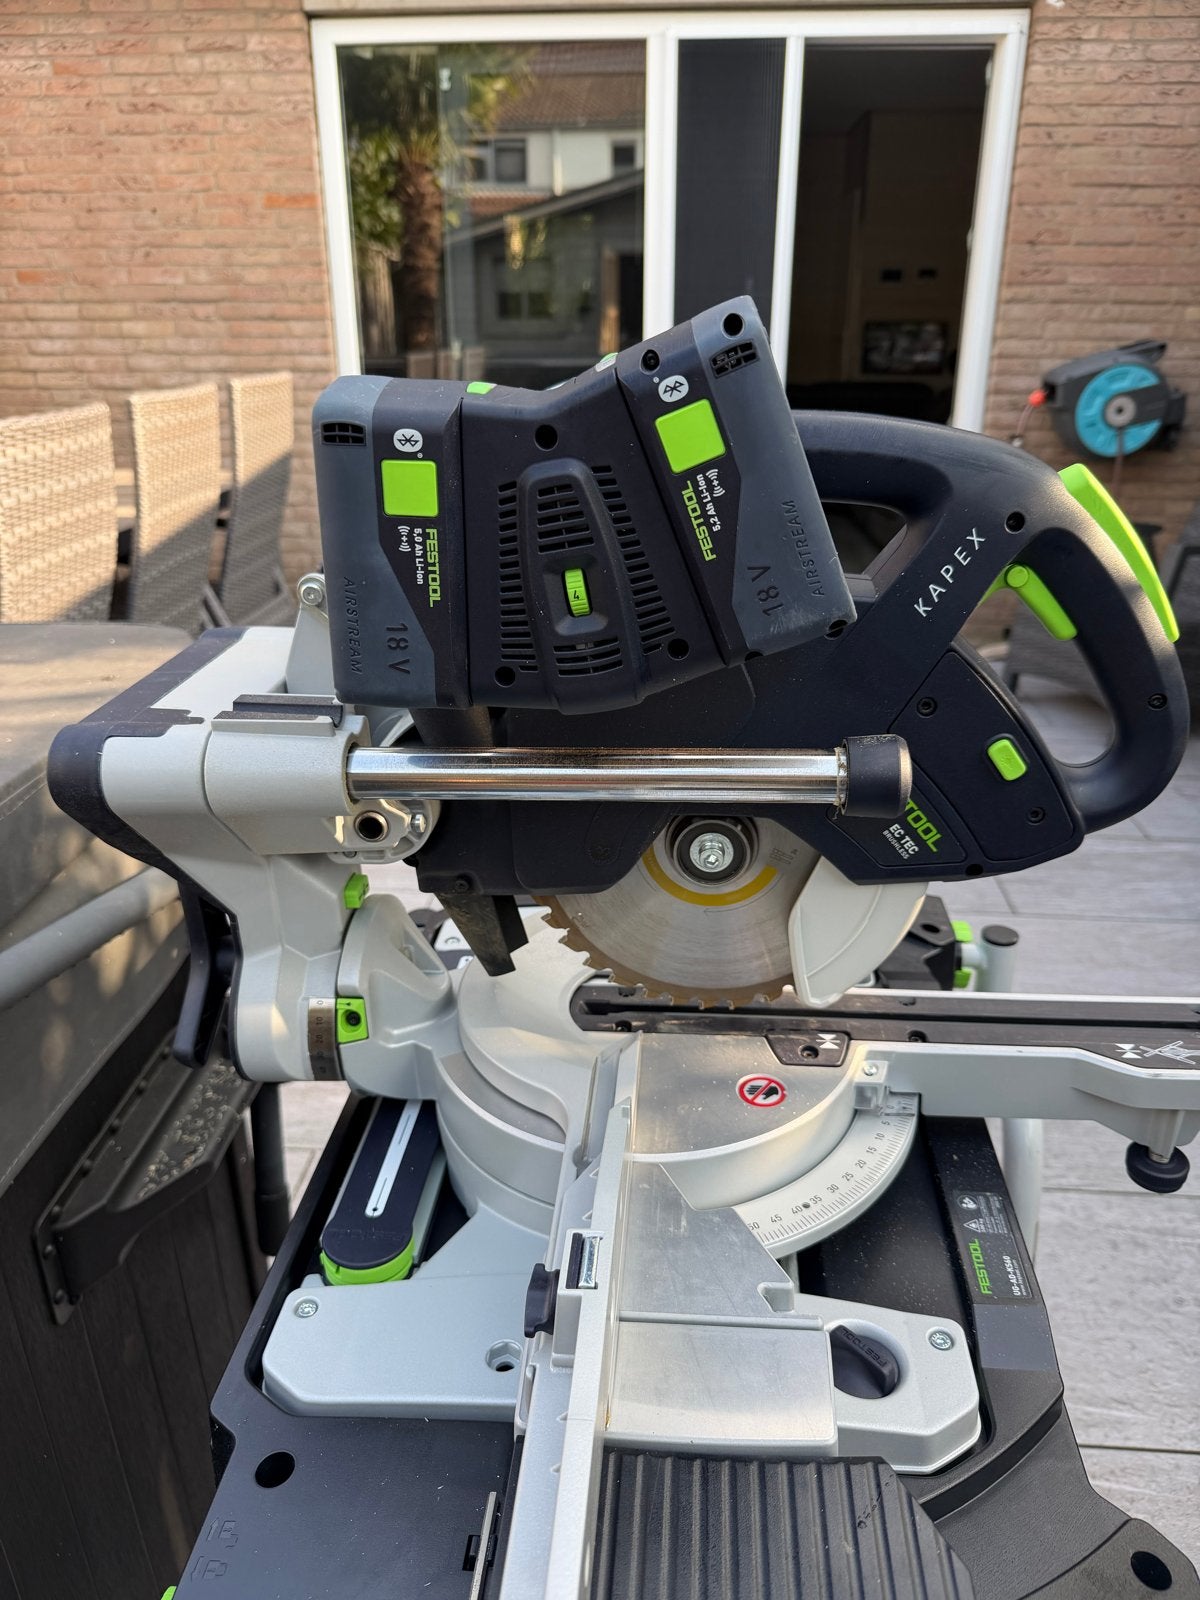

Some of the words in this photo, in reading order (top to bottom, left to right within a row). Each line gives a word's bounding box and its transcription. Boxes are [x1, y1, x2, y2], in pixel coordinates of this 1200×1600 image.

[696, 473, 712, 503] Li-Ion
[681, 480, 717, 561] FESTOOL
[705, 502, 717, 516] Ah
[709, 516, 721, 532] 5,2
[414, 543, 424, 557] Ah
[780, 500, 825, 597] AIRSTREAM
[415, 558, 425, 585] Li-Ion
[425, 528, 441, 608] FESTOOL
[747, 565, 771, 583] V
[914, 527, 987, 617] KAPEX
[573, 590, 581, 600] 4
[756, 585, 784, 618] 18
[343, 576, 363, 675] AIRSTREAM
[385, 622, 409, 651] 18
[388, 658, 411, 675] V
[889, 823, 905, 838] EC
[900, 835, 919, 855] TEC
[905, 799, 943, 852] TOOL
[882, 830, 910, 860] BRUSHLESS
[770, 1213, 783, 1223] 45
[791, 1205, 804, 1215] 40
[809, 1194, 823, 1205] 35
[826, 1183, 839, 1194] 30
[842, 1172, 854, 1182] 25
[855, 1159, 867, 1169] 20
[866, 1146, 878, 1155] 15
[875, 1132, 885, 1141] 10
[968, 1239, 993, 1295] FESTOOL
[1002, 1255, 1021, 1297] UG-AD-KS60
